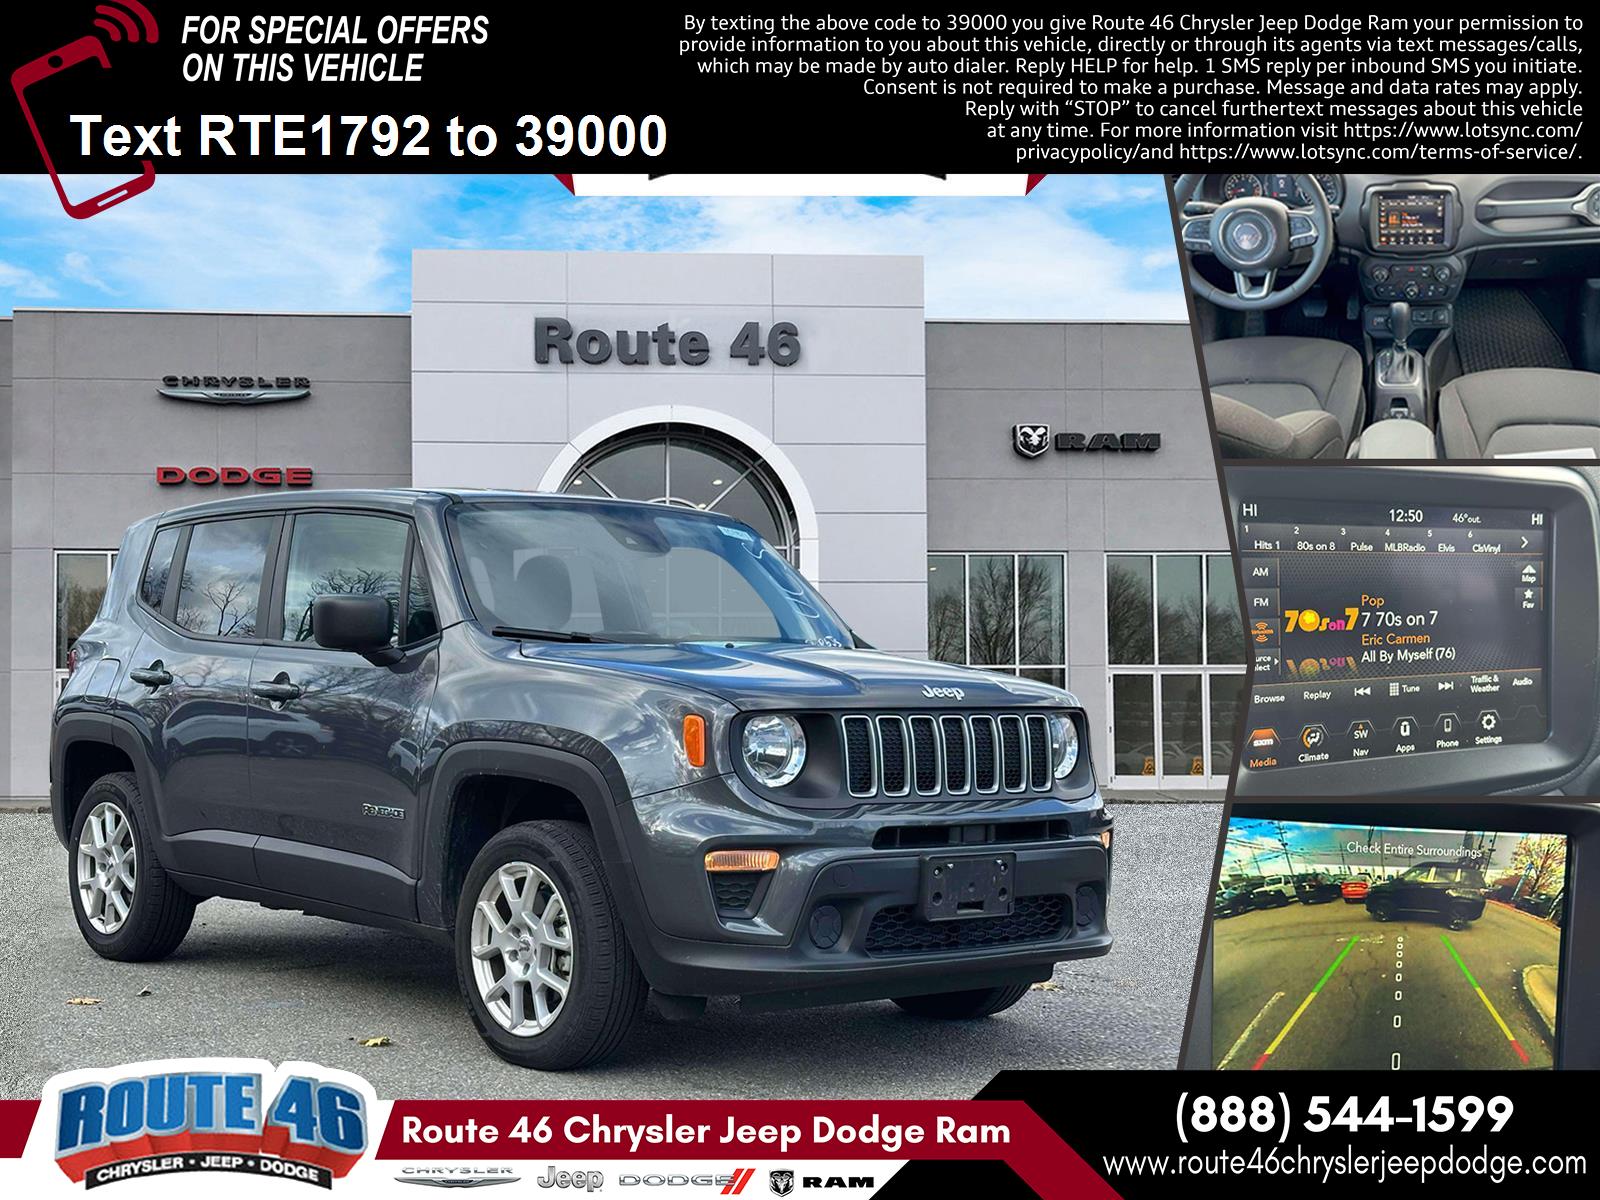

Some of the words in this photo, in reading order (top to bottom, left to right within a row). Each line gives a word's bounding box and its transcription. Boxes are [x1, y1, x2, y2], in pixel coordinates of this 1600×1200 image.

[534, 317, 710, 366] Route
[730, 321, 802, 367] 46
[162, 375, 311, 388] CHRYSLER
[1054, 433, 1161, 452] RAM
[156, 467, 313, 486] DODGE
[1242, 503, 1258, 517] HI
[1389, 509, 1423, 523] 12:50
[1531, 513, 1543, 526] HI
[1244, 525, 1249, 533] 1
[1294, 526, 1300, 535] 2
[1340, 528, 1346, 536] 3
[1385, 529, 1390, 537] 4
[1427, 529, 1433, 538] 5
[1467, 530, 1473, 538] 6
[1254, 540, 1273, 550] Hits
[1275, 540, 1280, 550] 1
[1297, 541, 1314, 551] 80s
[1316, 543, 1328, 551] on
[1329, 541, 1336, 551] 8
[1350, 542, 1373, 552] Pulse
[1252, 567, 1269, 577] AM
[1254, 597, 1269, 607] FM
[1361, 594, 1385, 608] Pop
[1361, 612, 1371, 627] 7
[1376, 611, 1402, 627] 70s
[1406, 614, 1425, 626] on
[1429, 610, 1439, 625] 7
[1361, 633, 1383, 646] Eric
[1386, 633, 1431, 645] Carmen
[1361, 649, 1376, 663] All
[1380, 650, 1394, 664] By
[1397, 647, 1434, 663] Myself
[1435, 647, 1456, 661] (76)
[1512, 677, 1533, 686] Audio
[921, 684, 965, 700] Jeep
[1402, 685, 1420, 693] Tune
[1470, 684, 1500, 693] Weather
[1254, 694, 1285, 704] Browse
[1303, 690, 1331, 701] Replay
[1436, 739, 1459, 748] Phone
[1475, 735, 1503, 745] Settings
[1353, 748, 1369, 757] Nav
[1395, 744, 1415, 753] Apps
[1249, 757, 1277, 768] Media
[1298, 752, 1329, 763] Climate
[1346, 841, 1381, 854] Check
[1384, 843, 1414, 855] Entire
[1416, 844, 1482, 860] Surroundings
